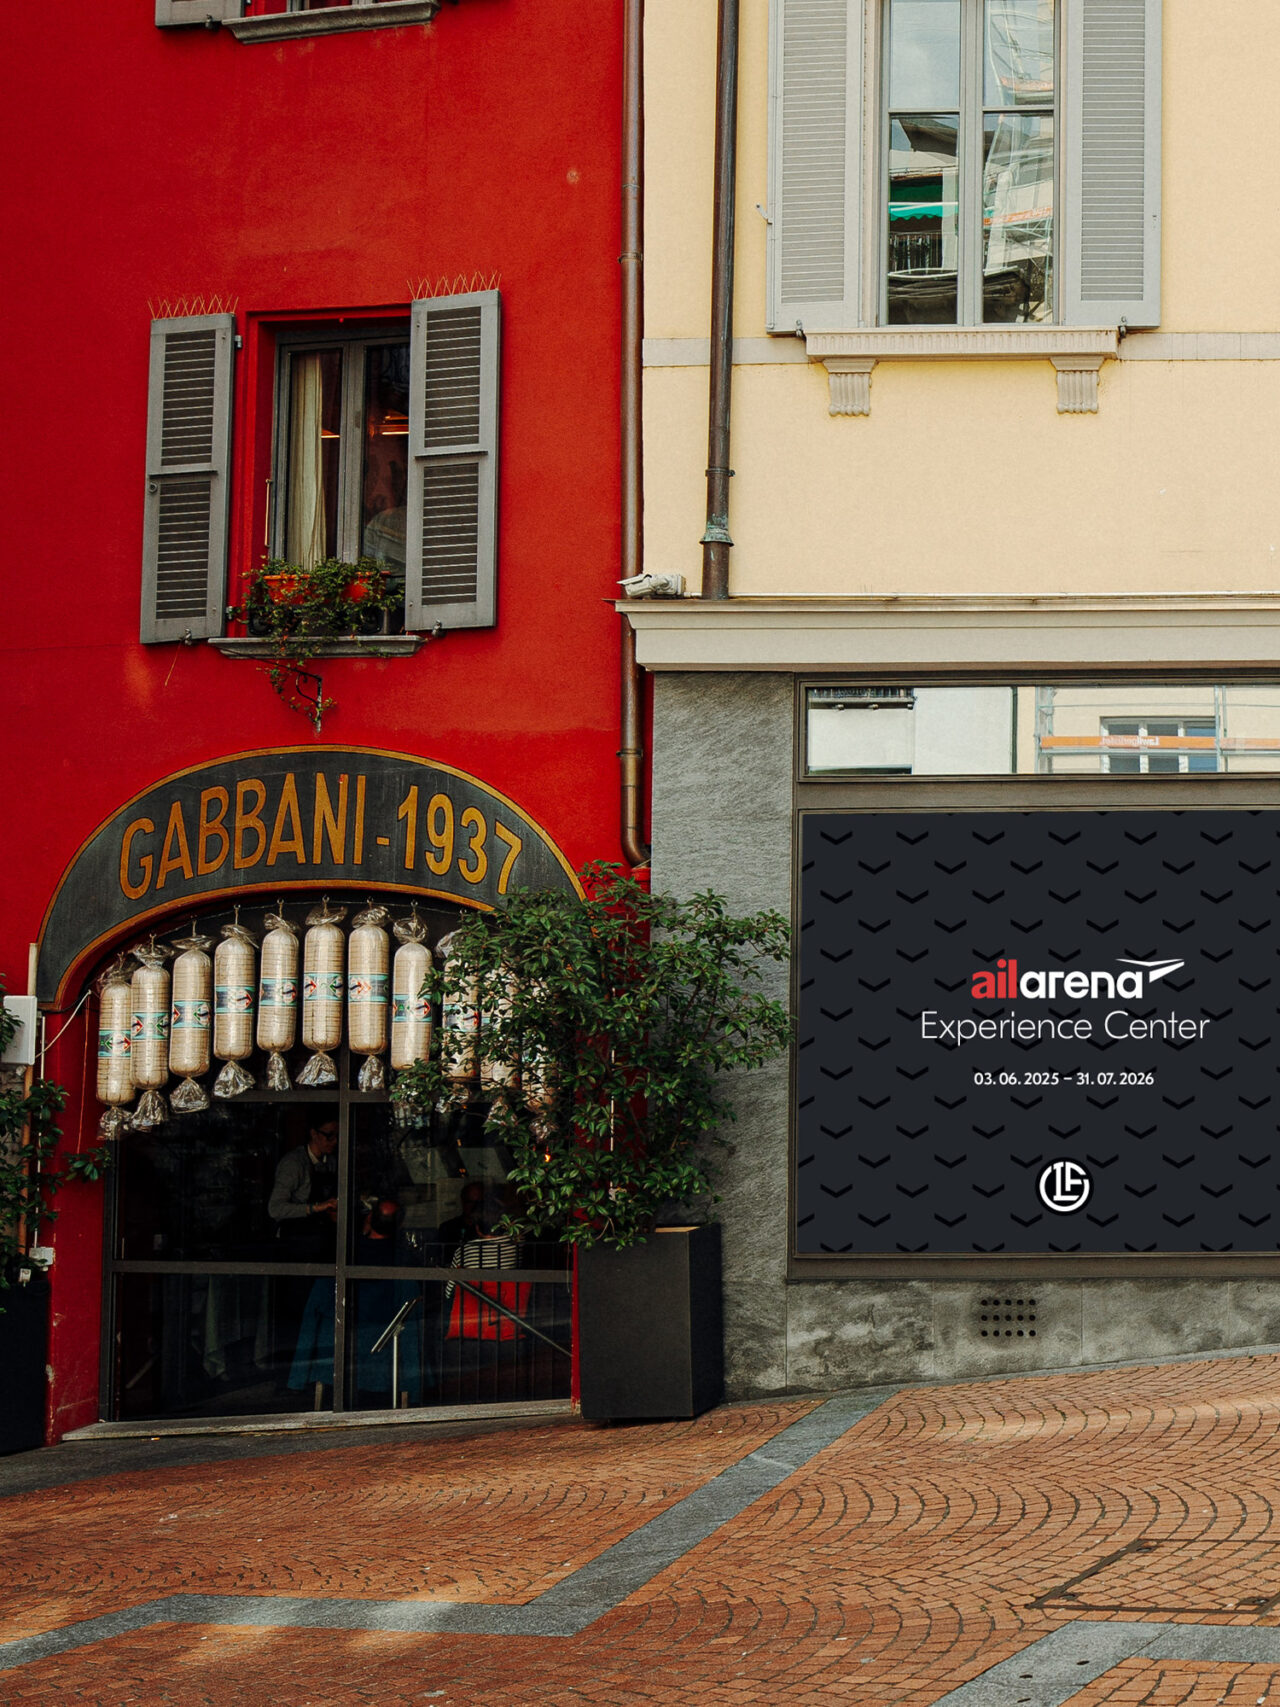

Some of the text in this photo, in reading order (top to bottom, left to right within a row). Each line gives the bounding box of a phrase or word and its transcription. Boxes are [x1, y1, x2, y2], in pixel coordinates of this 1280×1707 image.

[119, 772, 366, 899] GABBANI
[398, 785, 522, 895] 1937
[921, 1010, 1211, 1047] Experience Center
